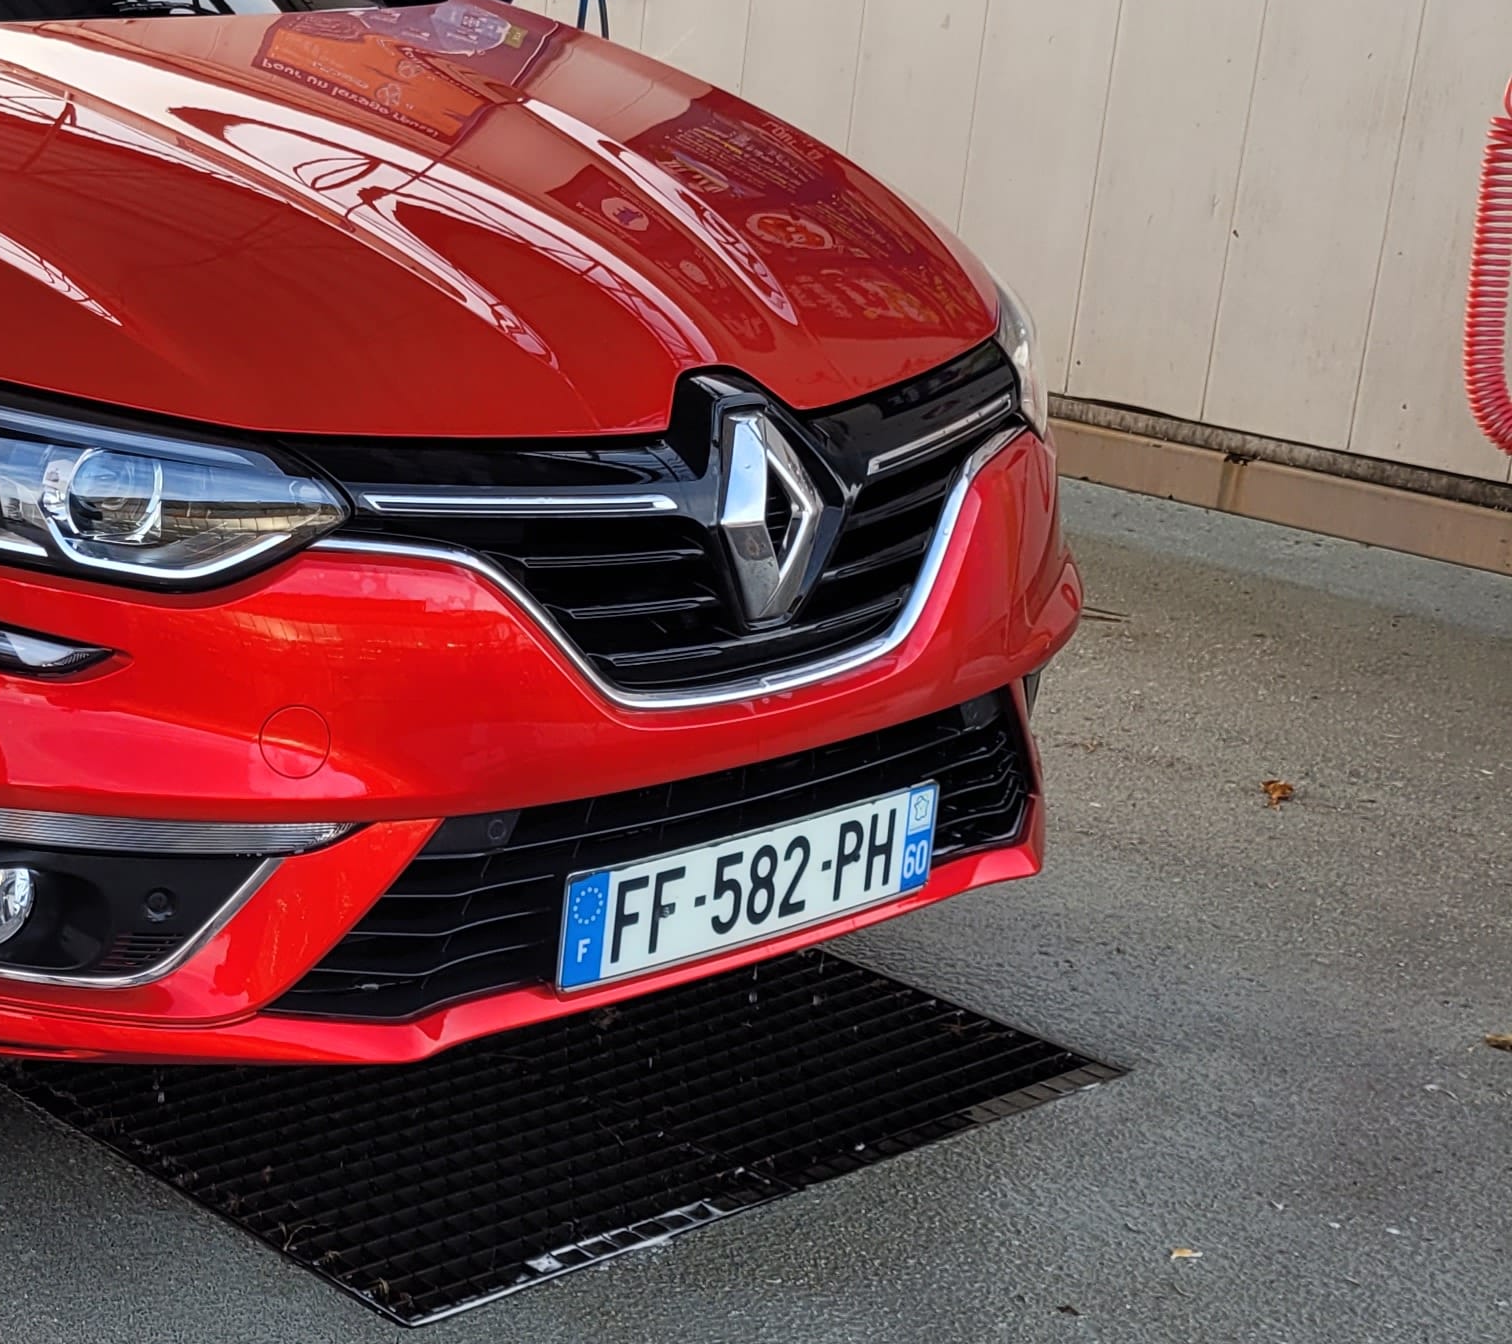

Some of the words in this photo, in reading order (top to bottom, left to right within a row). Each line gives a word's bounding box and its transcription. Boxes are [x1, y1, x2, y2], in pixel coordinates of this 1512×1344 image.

[903, 839, 929, 879] 60
[609, 808, 897, 964] FF-582-PH
[576, 938, 591, 963] F
